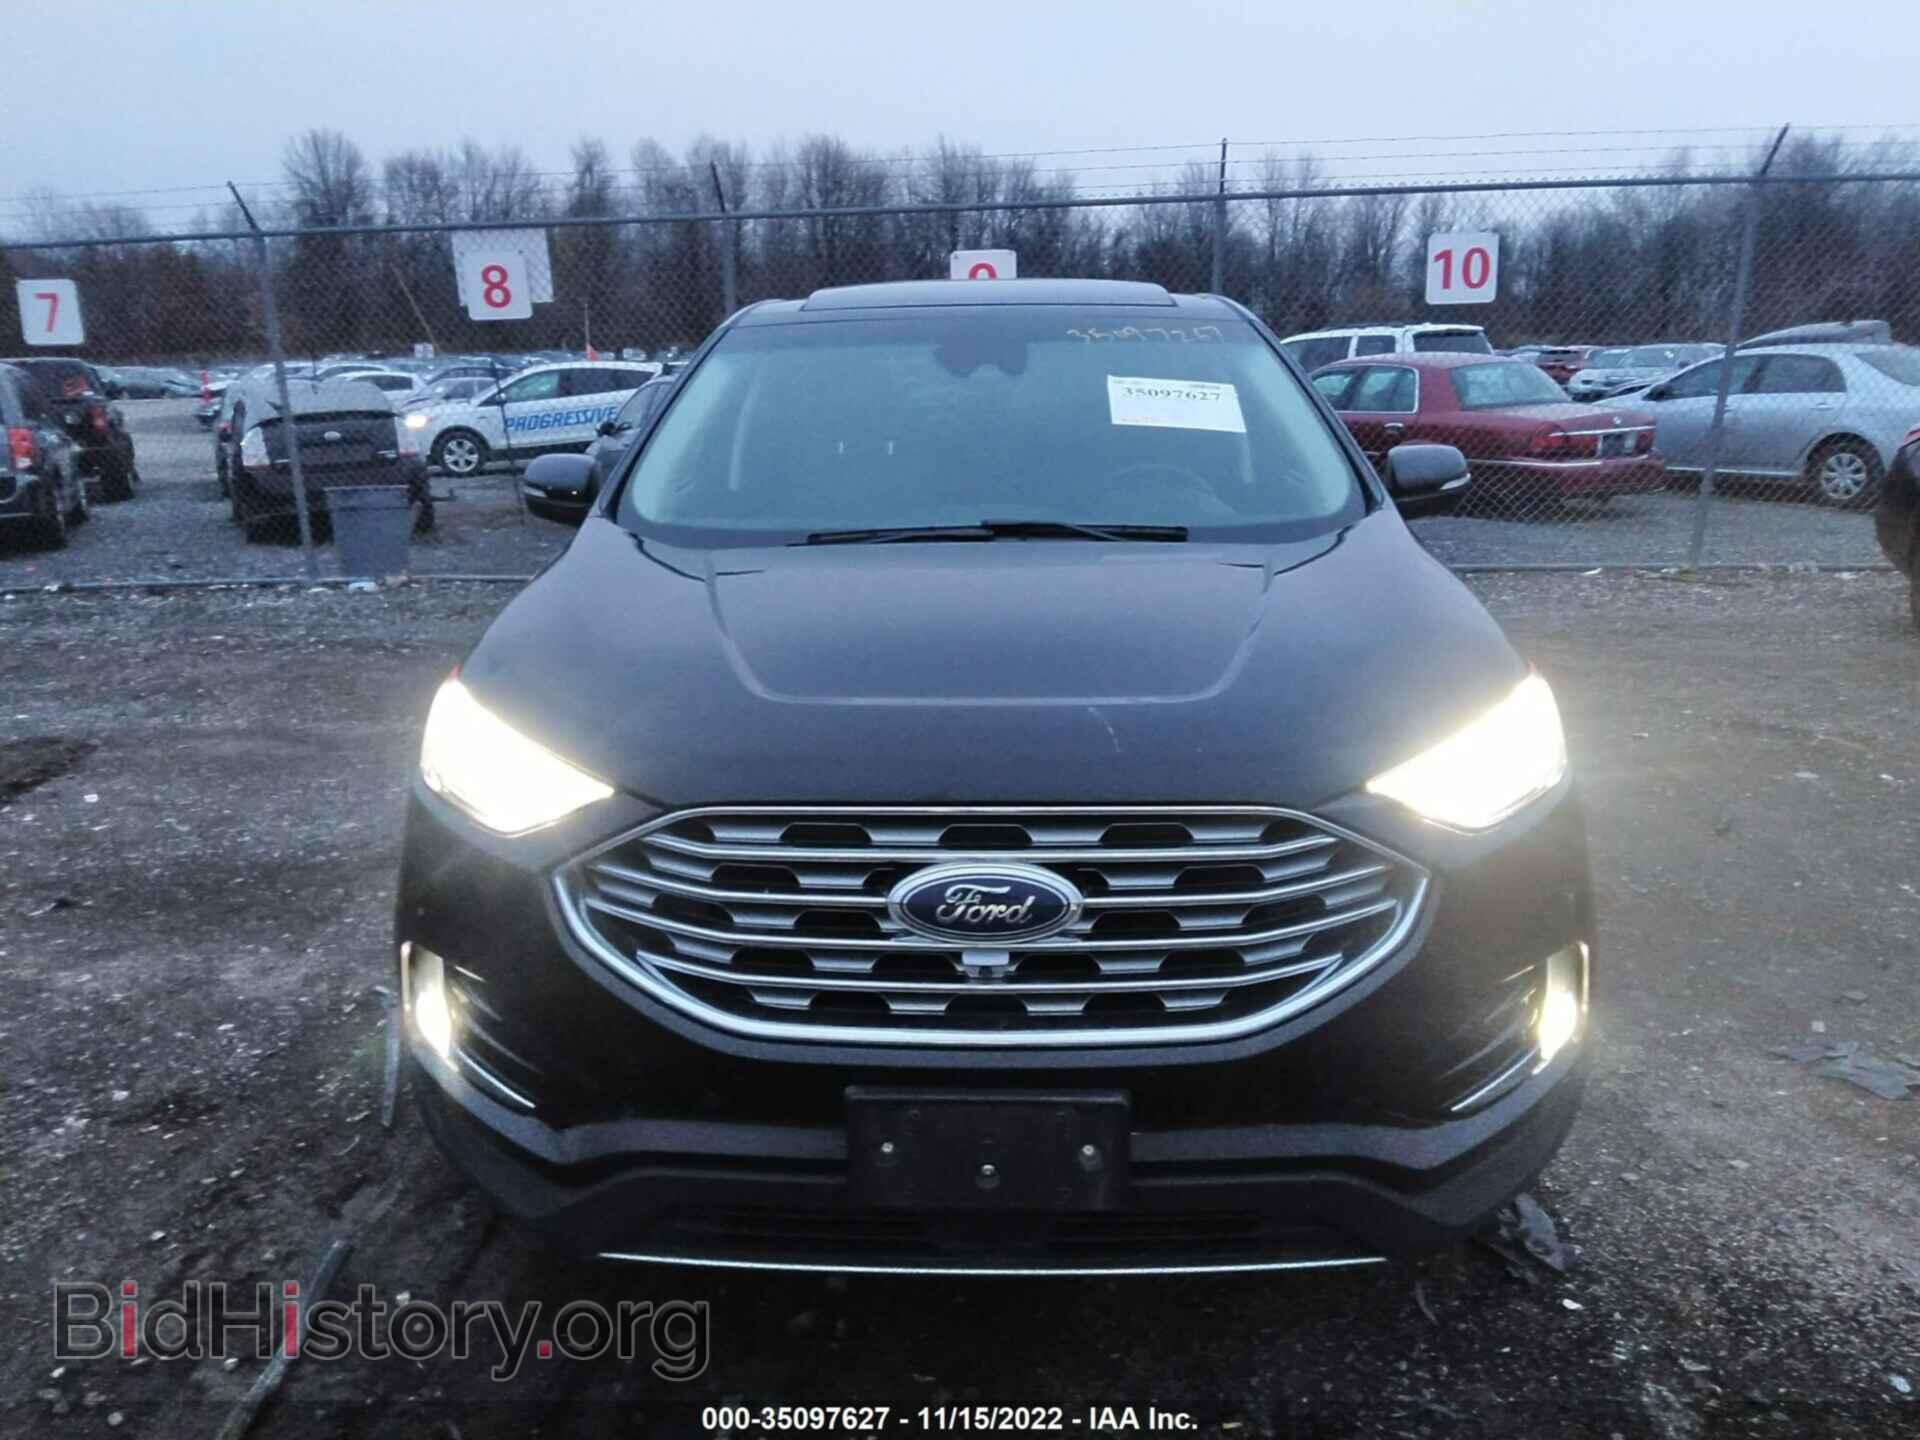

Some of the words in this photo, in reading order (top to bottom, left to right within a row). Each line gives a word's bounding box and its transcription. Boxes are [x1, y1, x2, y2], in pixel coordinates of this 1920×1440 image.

[481, 265, 512, 309] 8
[1434, 247, 1490, 290] 10
[35, 292, 59, 332] 7
[1123, 386, 1221, 401] 35097627
[504, 406, 619, 432] PROGRESSIVE
[936, 884, 1036, 923] Ford
